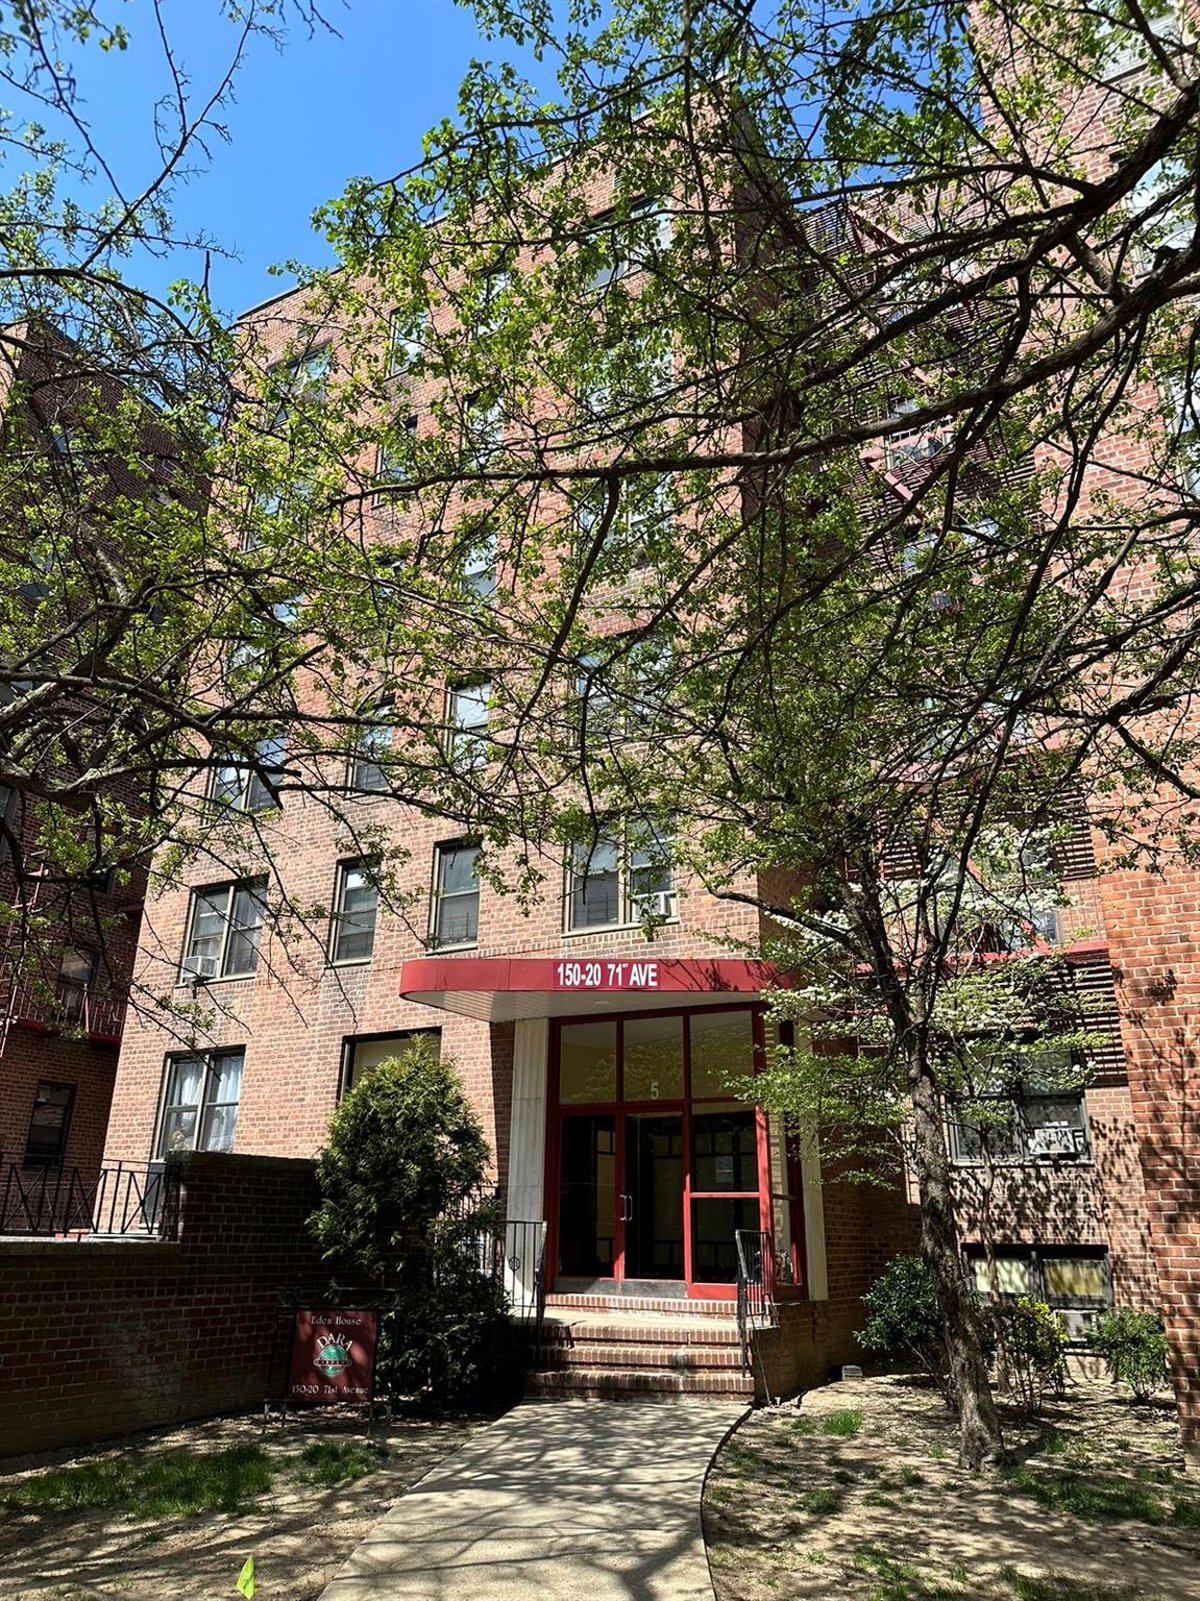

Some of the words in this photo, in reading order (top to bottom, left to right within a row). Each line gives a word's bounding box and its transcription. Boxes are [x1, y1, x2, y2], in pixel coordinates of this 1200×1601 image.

[557, 963, 602, 986] 150-20
[629, 963, 658, 987] AVE
[650, 1082, 659, 1100] 5
[335, 1316, 362, 1326] House
[316, 1333, 353, 1352] DARA
[292, 1384, 319, 1394] 150-20
